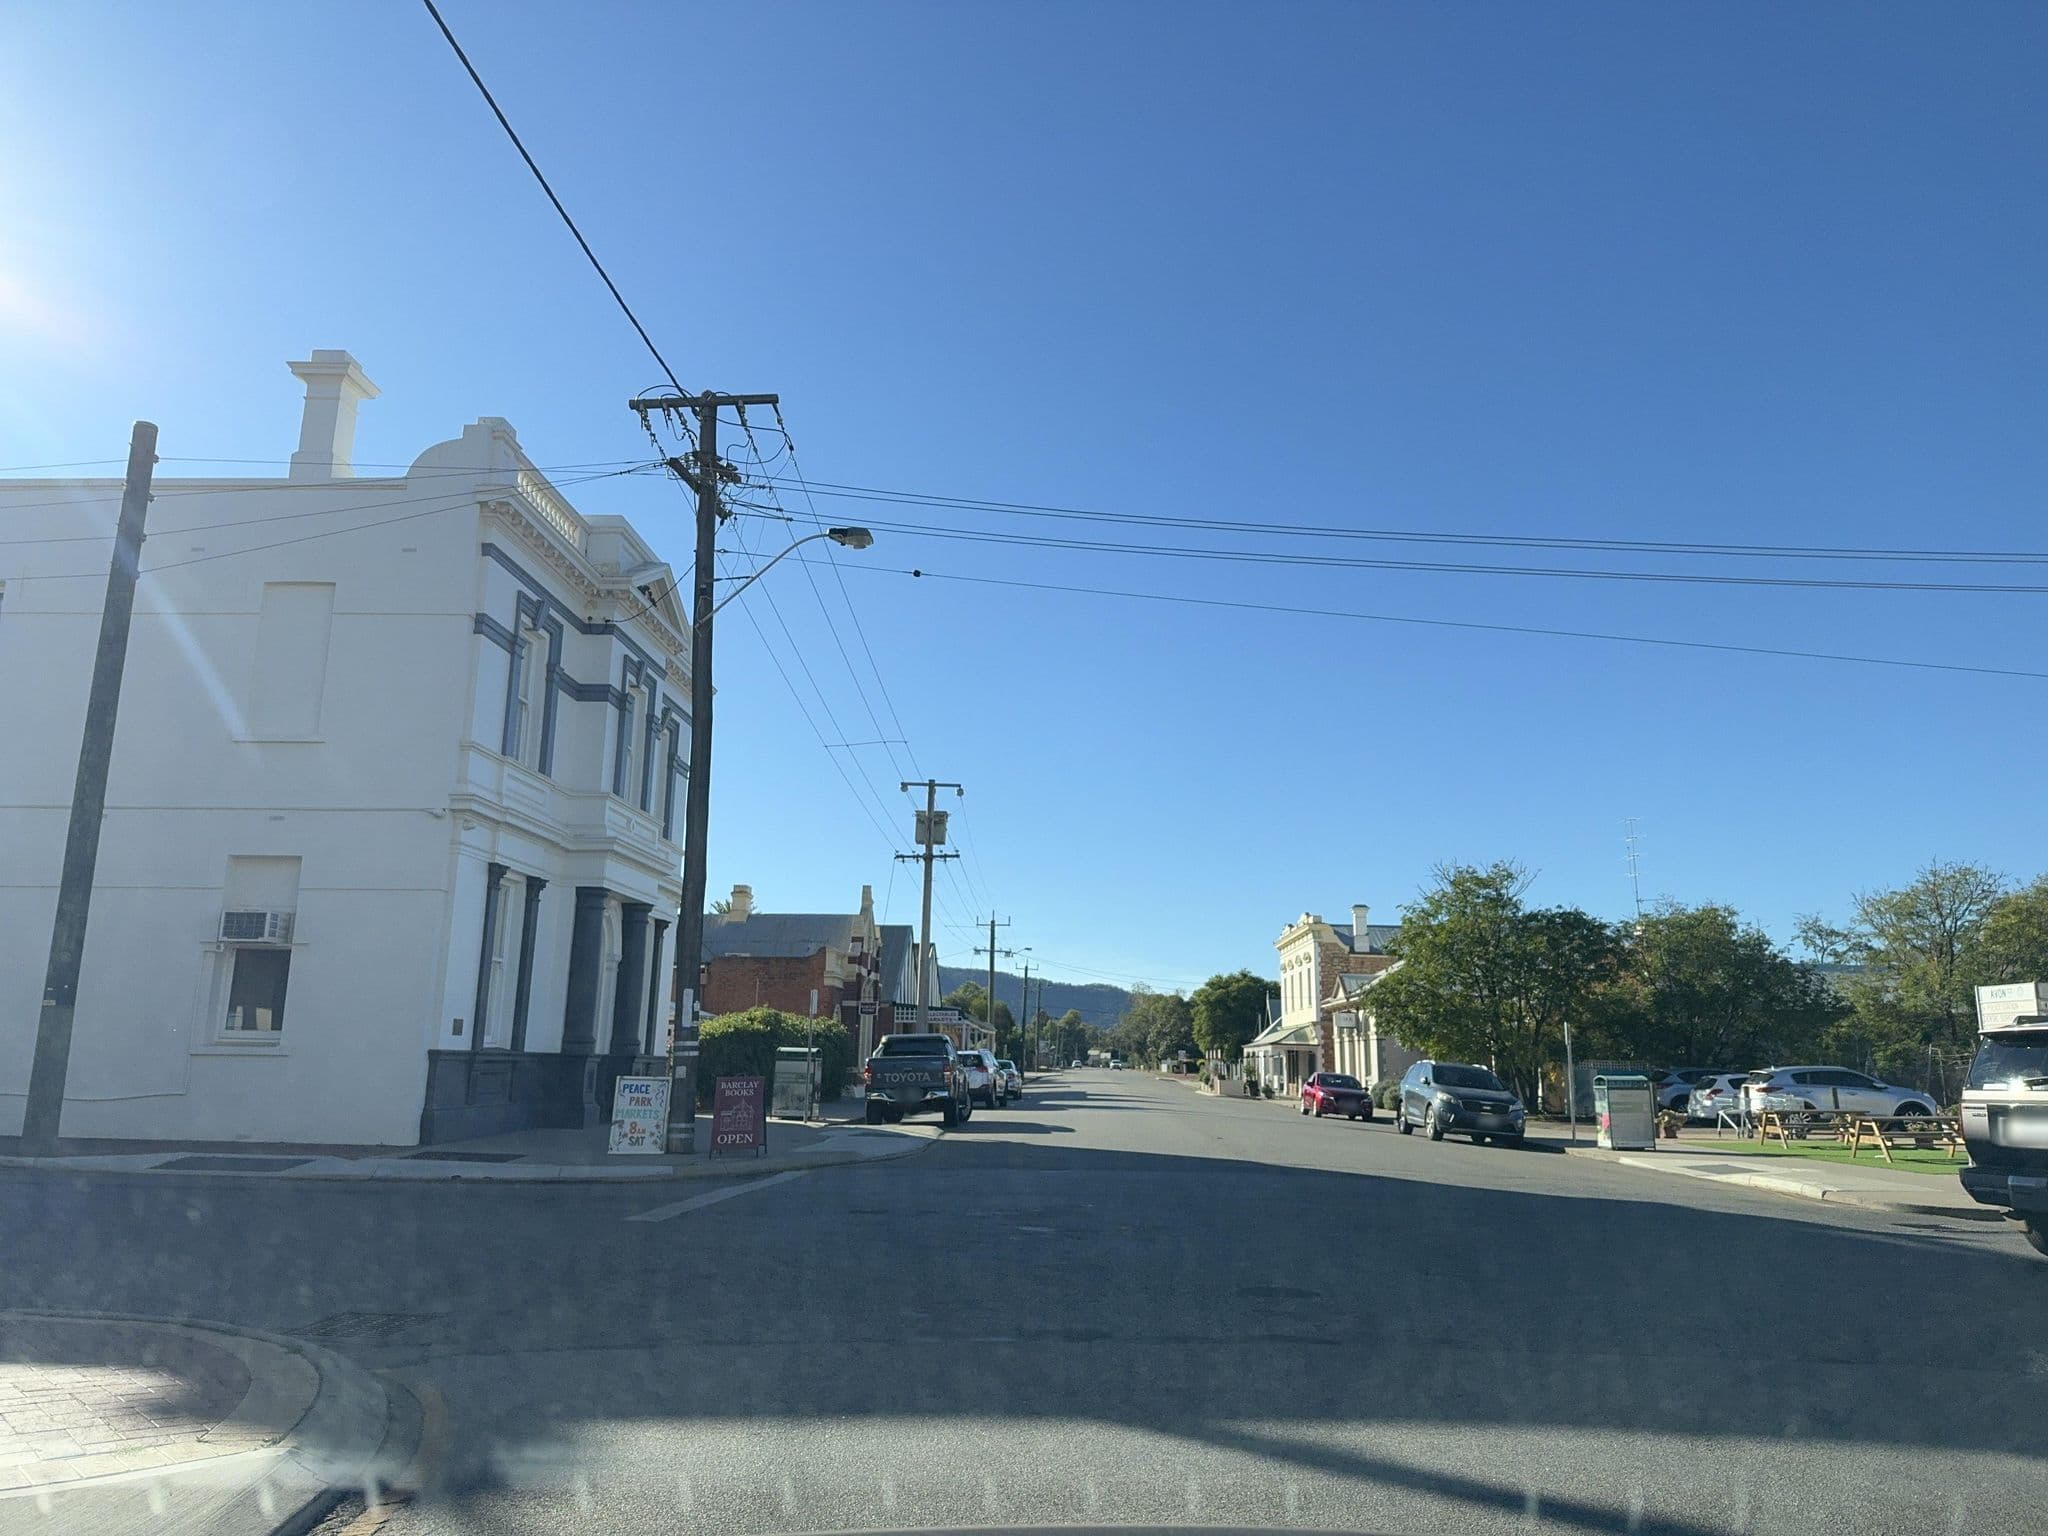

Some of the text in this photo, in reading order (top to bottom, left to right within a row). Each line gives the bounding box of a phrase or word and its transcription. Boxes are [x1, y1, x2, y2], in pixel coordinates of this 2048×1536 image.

[884, 1072, 931, 1083] TOYOTA
[623, 1083, 650, 1094] PEACE
[721, 1081, 759, 1089] BARCLAY
[724, 1088, 755, 1097] BOOKS
[628, 1096, 653, 1106] PARK
[616, 1108, 660, 1120] MARKETS
[628, 1136, 645, 1146] SAT
[717, 1133, 754, 1145] OPEN
